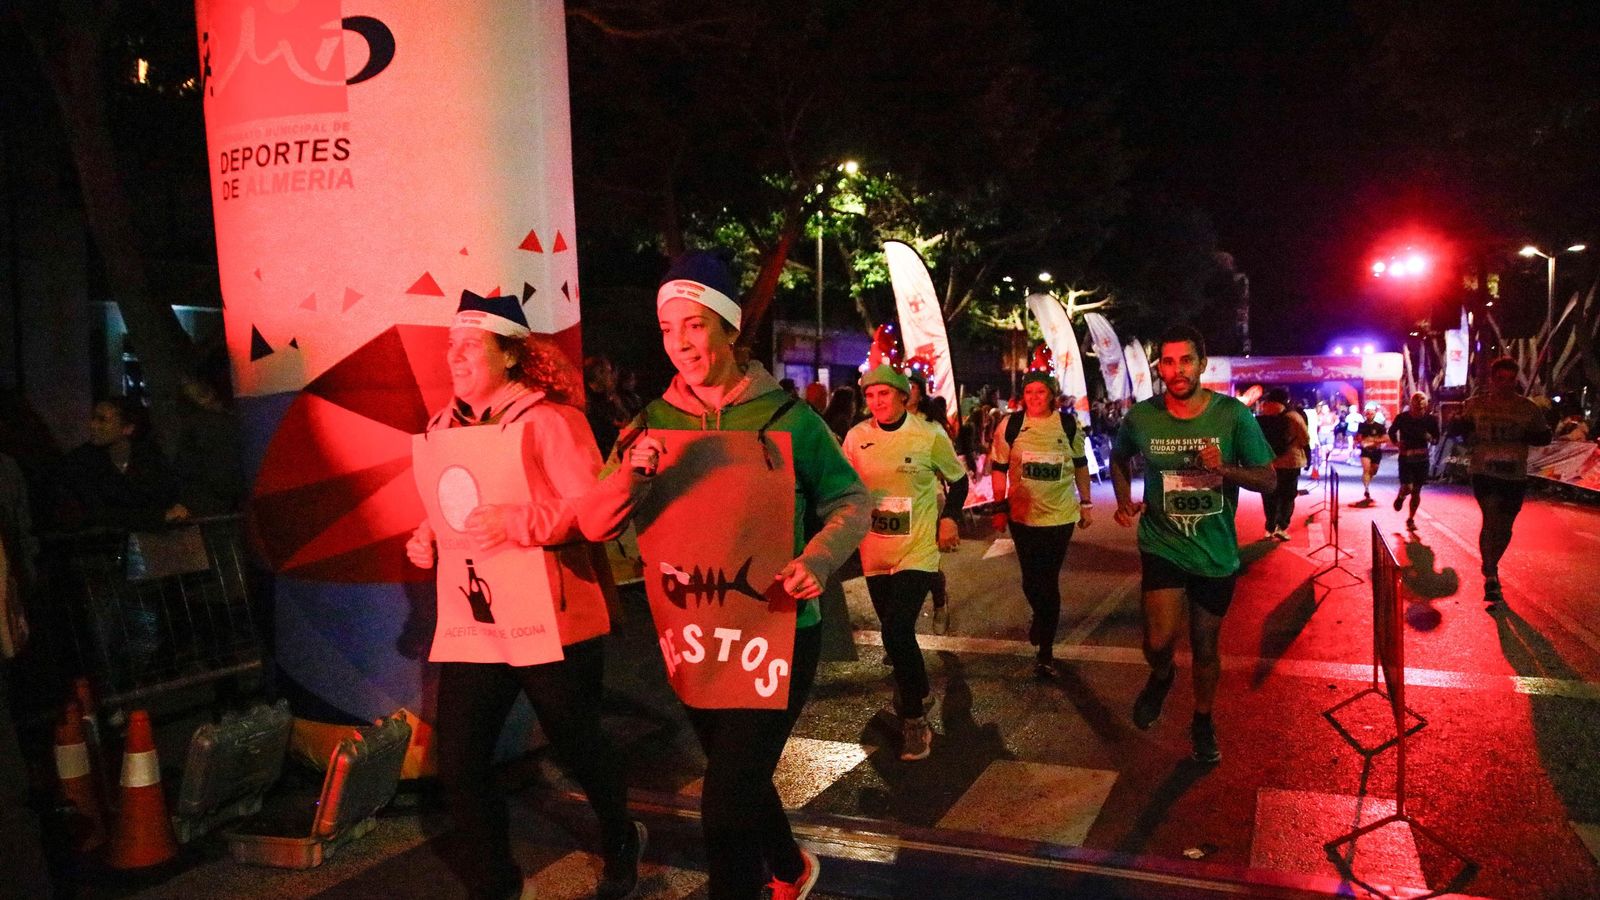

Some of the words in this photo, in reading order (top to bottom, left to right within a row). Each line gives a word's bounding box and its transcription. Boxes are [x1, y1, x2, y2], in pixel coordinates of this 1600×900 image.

[265, 122, 327, 137] MUNICIPAL
[333, 121, 350, 132] DE
[221, 138, 351, 174] DEPORTES
[223, 178, 240, 201] DE
[246, 168, 354, 195] ALMERIA
[1182, 437, 1220, 445] SILVERE
[1025, 465, 1060, 479] 1030
[1174, 496, 1212, 510] 693
[871, 516, 900, 531] 750
[444, 625, 479, 638] ACEITE
[510, 624, 546, 639] COCINA
[659, 624, 789, 697] RESTOS
